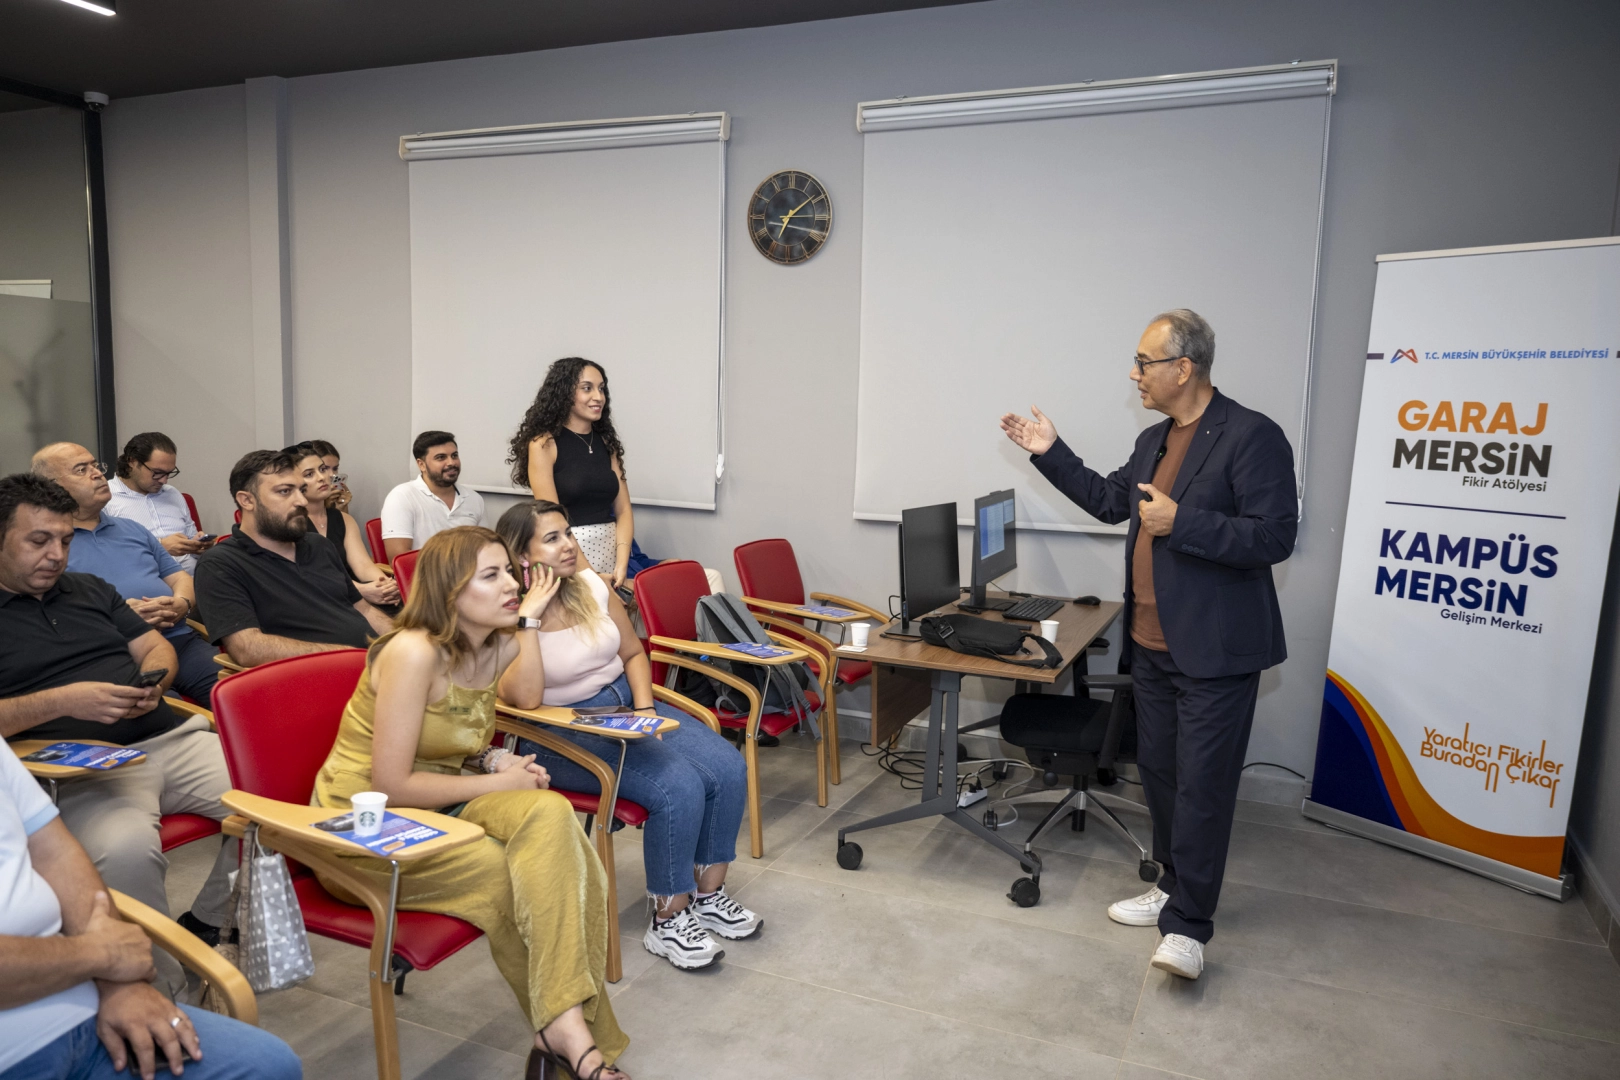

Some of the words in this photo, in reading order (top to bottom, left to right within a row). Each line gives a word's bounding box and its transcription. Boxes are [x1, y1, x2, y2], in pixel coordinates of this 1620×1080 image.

[1425, 351, 1440, 360] T.C.
[1442, 349, 1480, 360] MERSİN
[1482, 348, 1547, 361] BÜYÜKŞEHİR
[1550, 347, 1610, 359] BELEDİYESİ
[1397, 399, 1549, 436] GARAJ
[1461, 475, 1490, 488] Fikir
[1492, 477, 1547, 492] Atölyesi
[1379, 528, 1560, 579] KAMPÜS
[1440, 608, 1487, 626] Gelişim
[1489, 615, 1543, 634] Merkezi
[1423, 722, 1492, 758] Yaratıcı
[1498, 739, 1564, 775] Fikirler
[1420, 741, 1500, 793] Buradan
[1505, 762, 1561, 808] Çıkar
